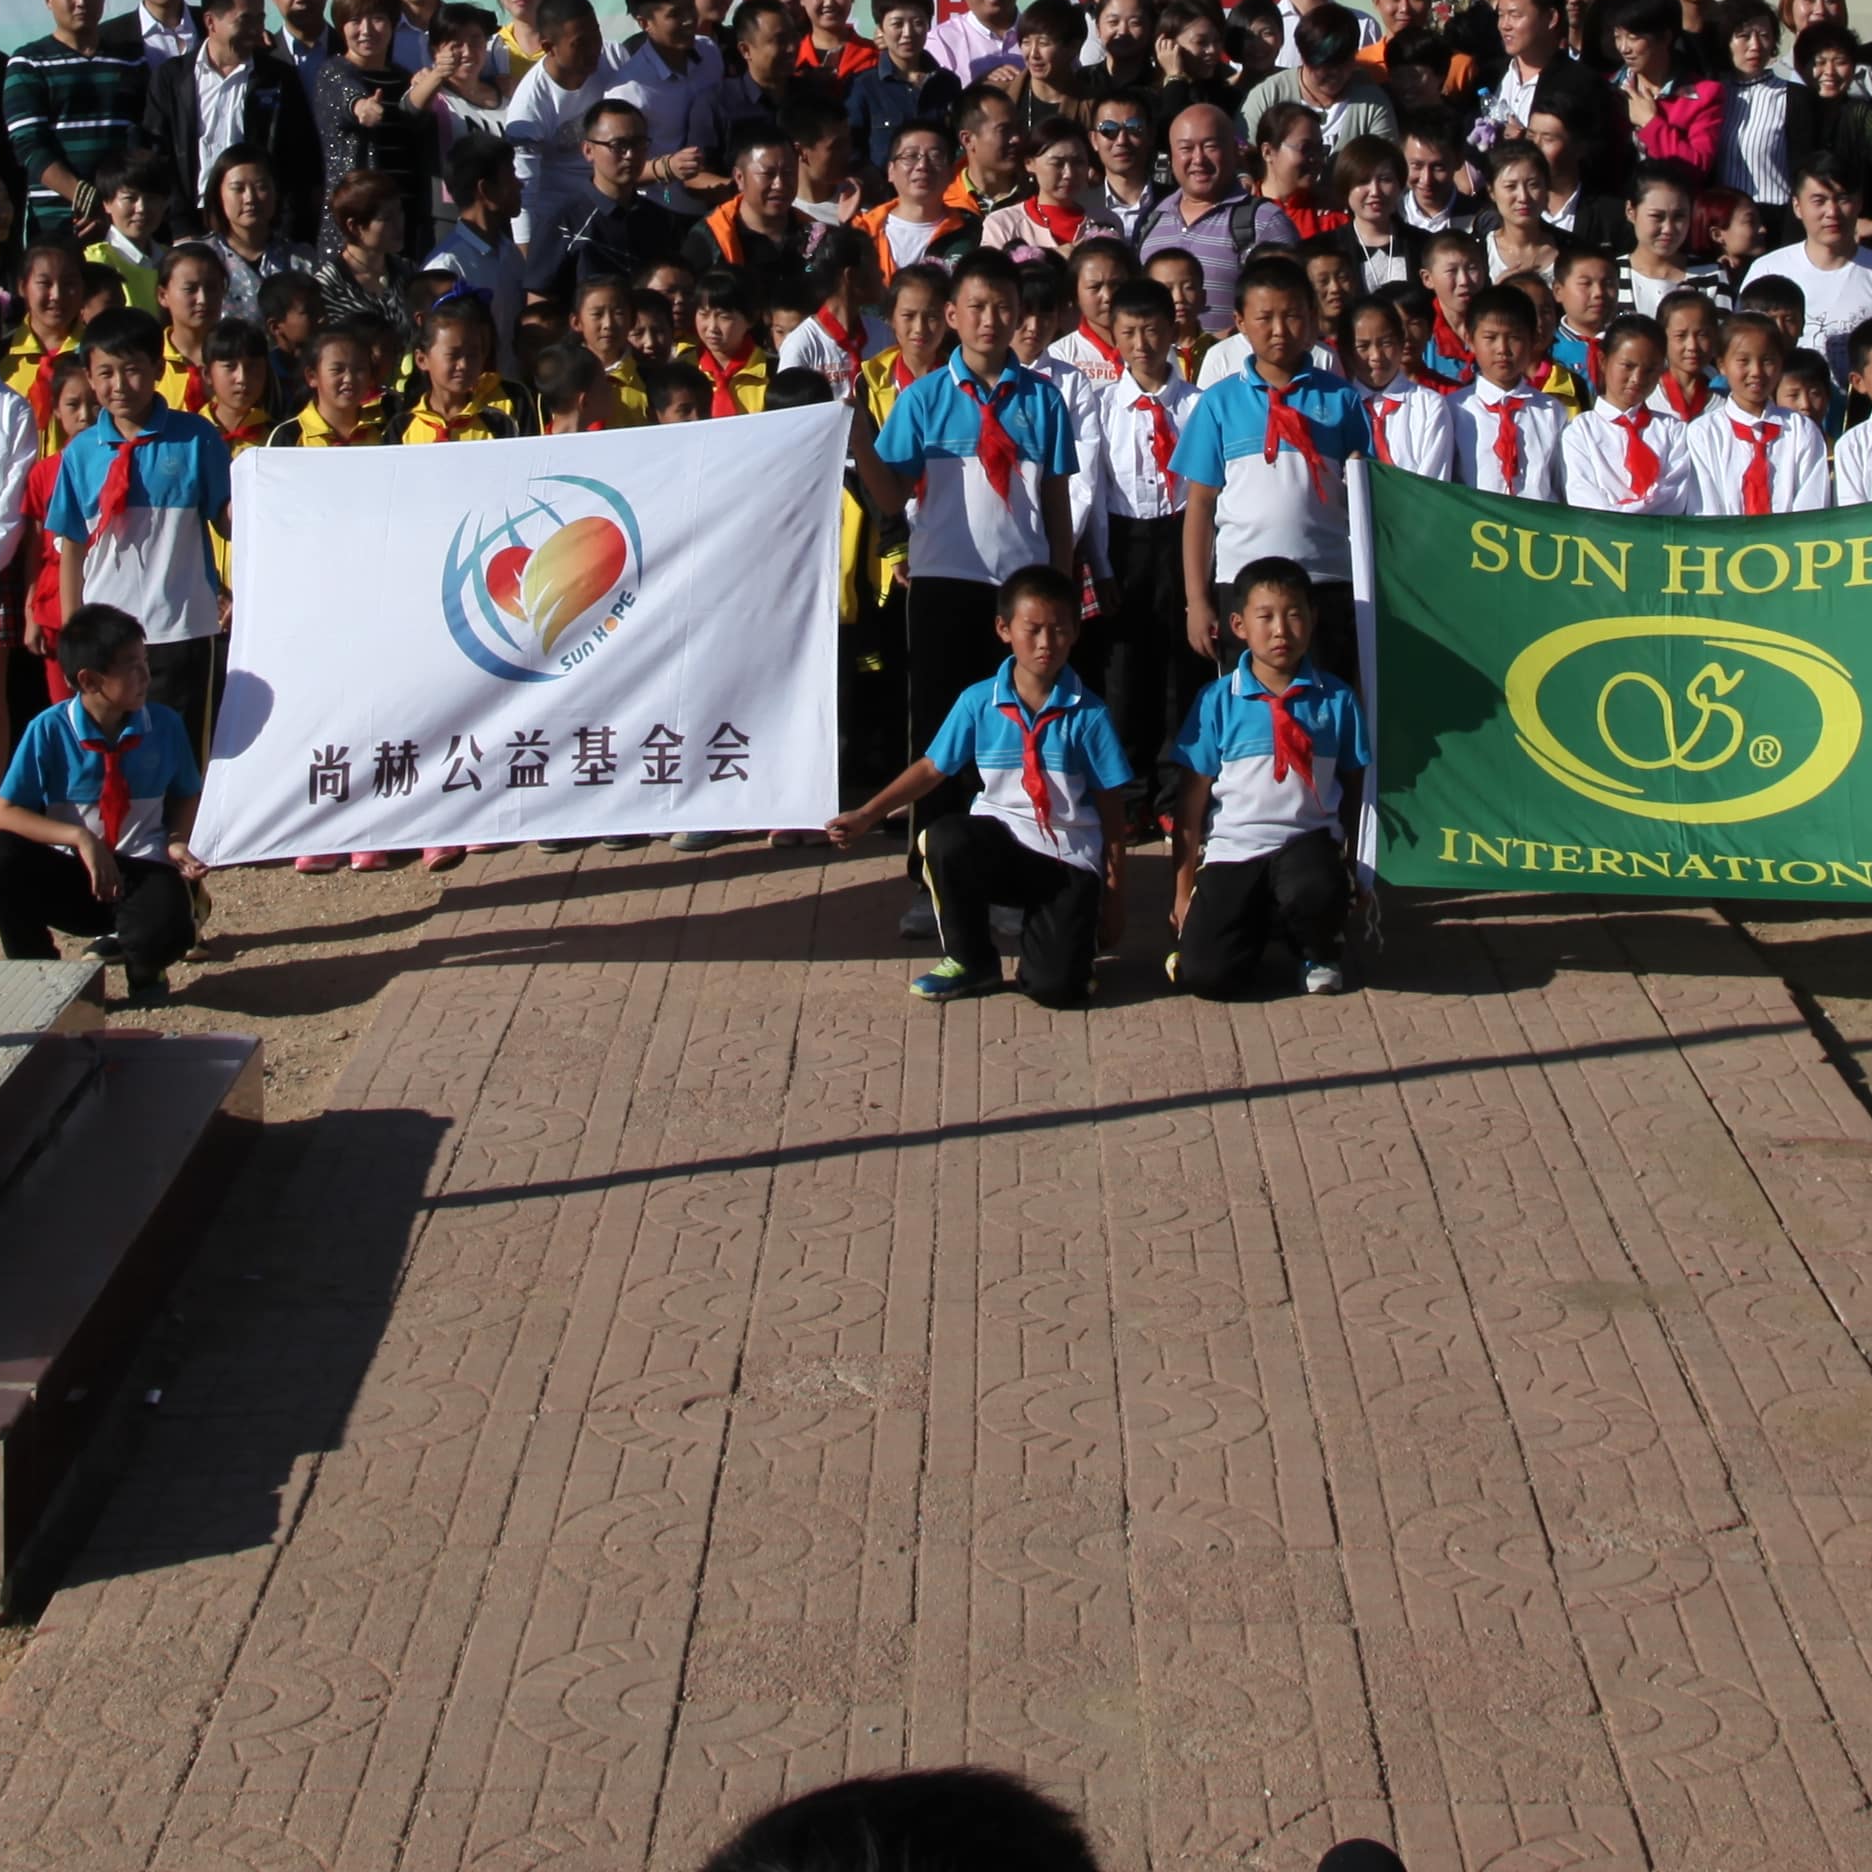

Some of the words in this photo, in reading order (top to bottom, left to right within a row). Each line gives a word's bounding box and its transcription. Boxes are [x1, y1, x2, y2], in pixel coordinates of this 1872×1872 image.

[1471, 520, 1632, 592] SUN
[308, 720, 751, 804] 尚赫公益基金会
